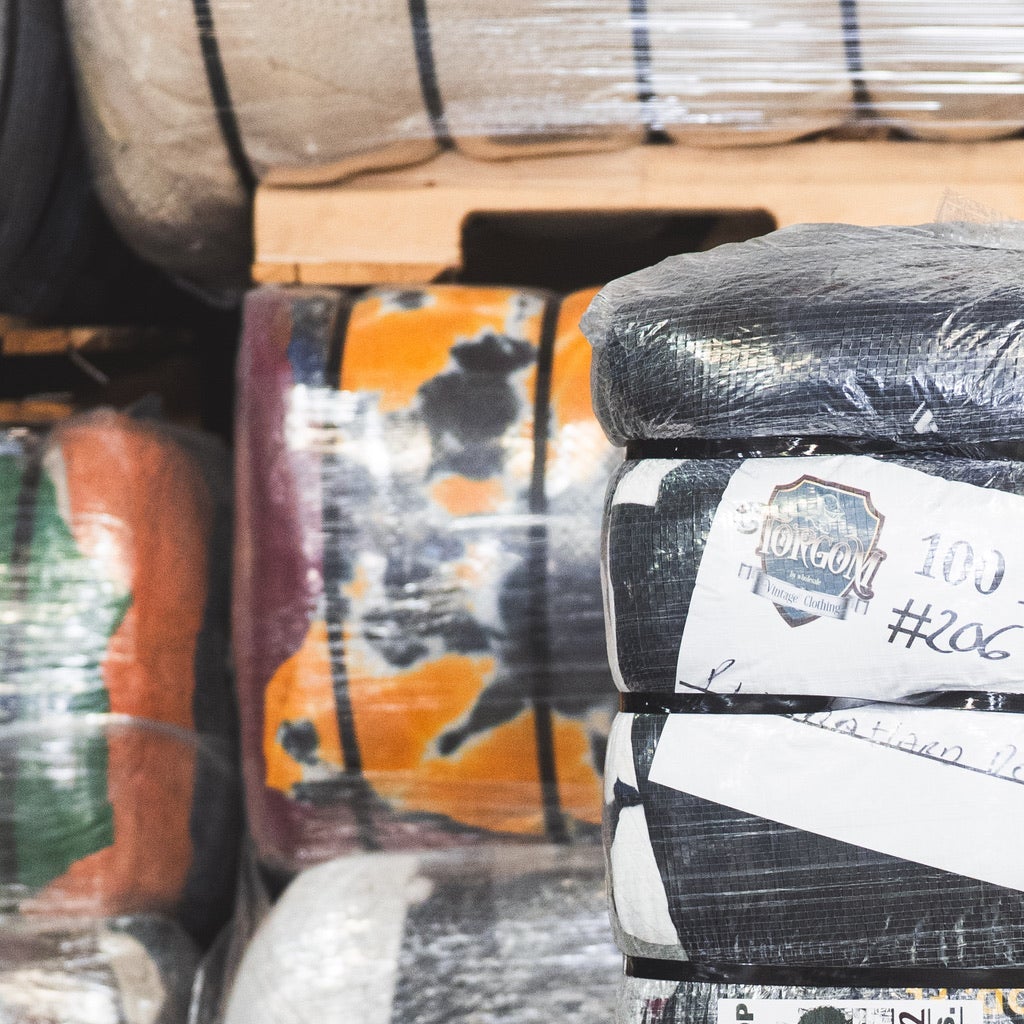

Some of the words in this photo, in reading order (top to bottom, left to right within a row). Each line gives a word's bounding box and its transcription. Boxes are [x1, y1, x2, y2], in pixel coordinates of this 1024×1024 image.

[914, 532, 1006, 595] 100
[765, 579, 799, 606] Vintage
[803, 594, 842, 616] Clothing
[887, 598, 1024, 661] #206
